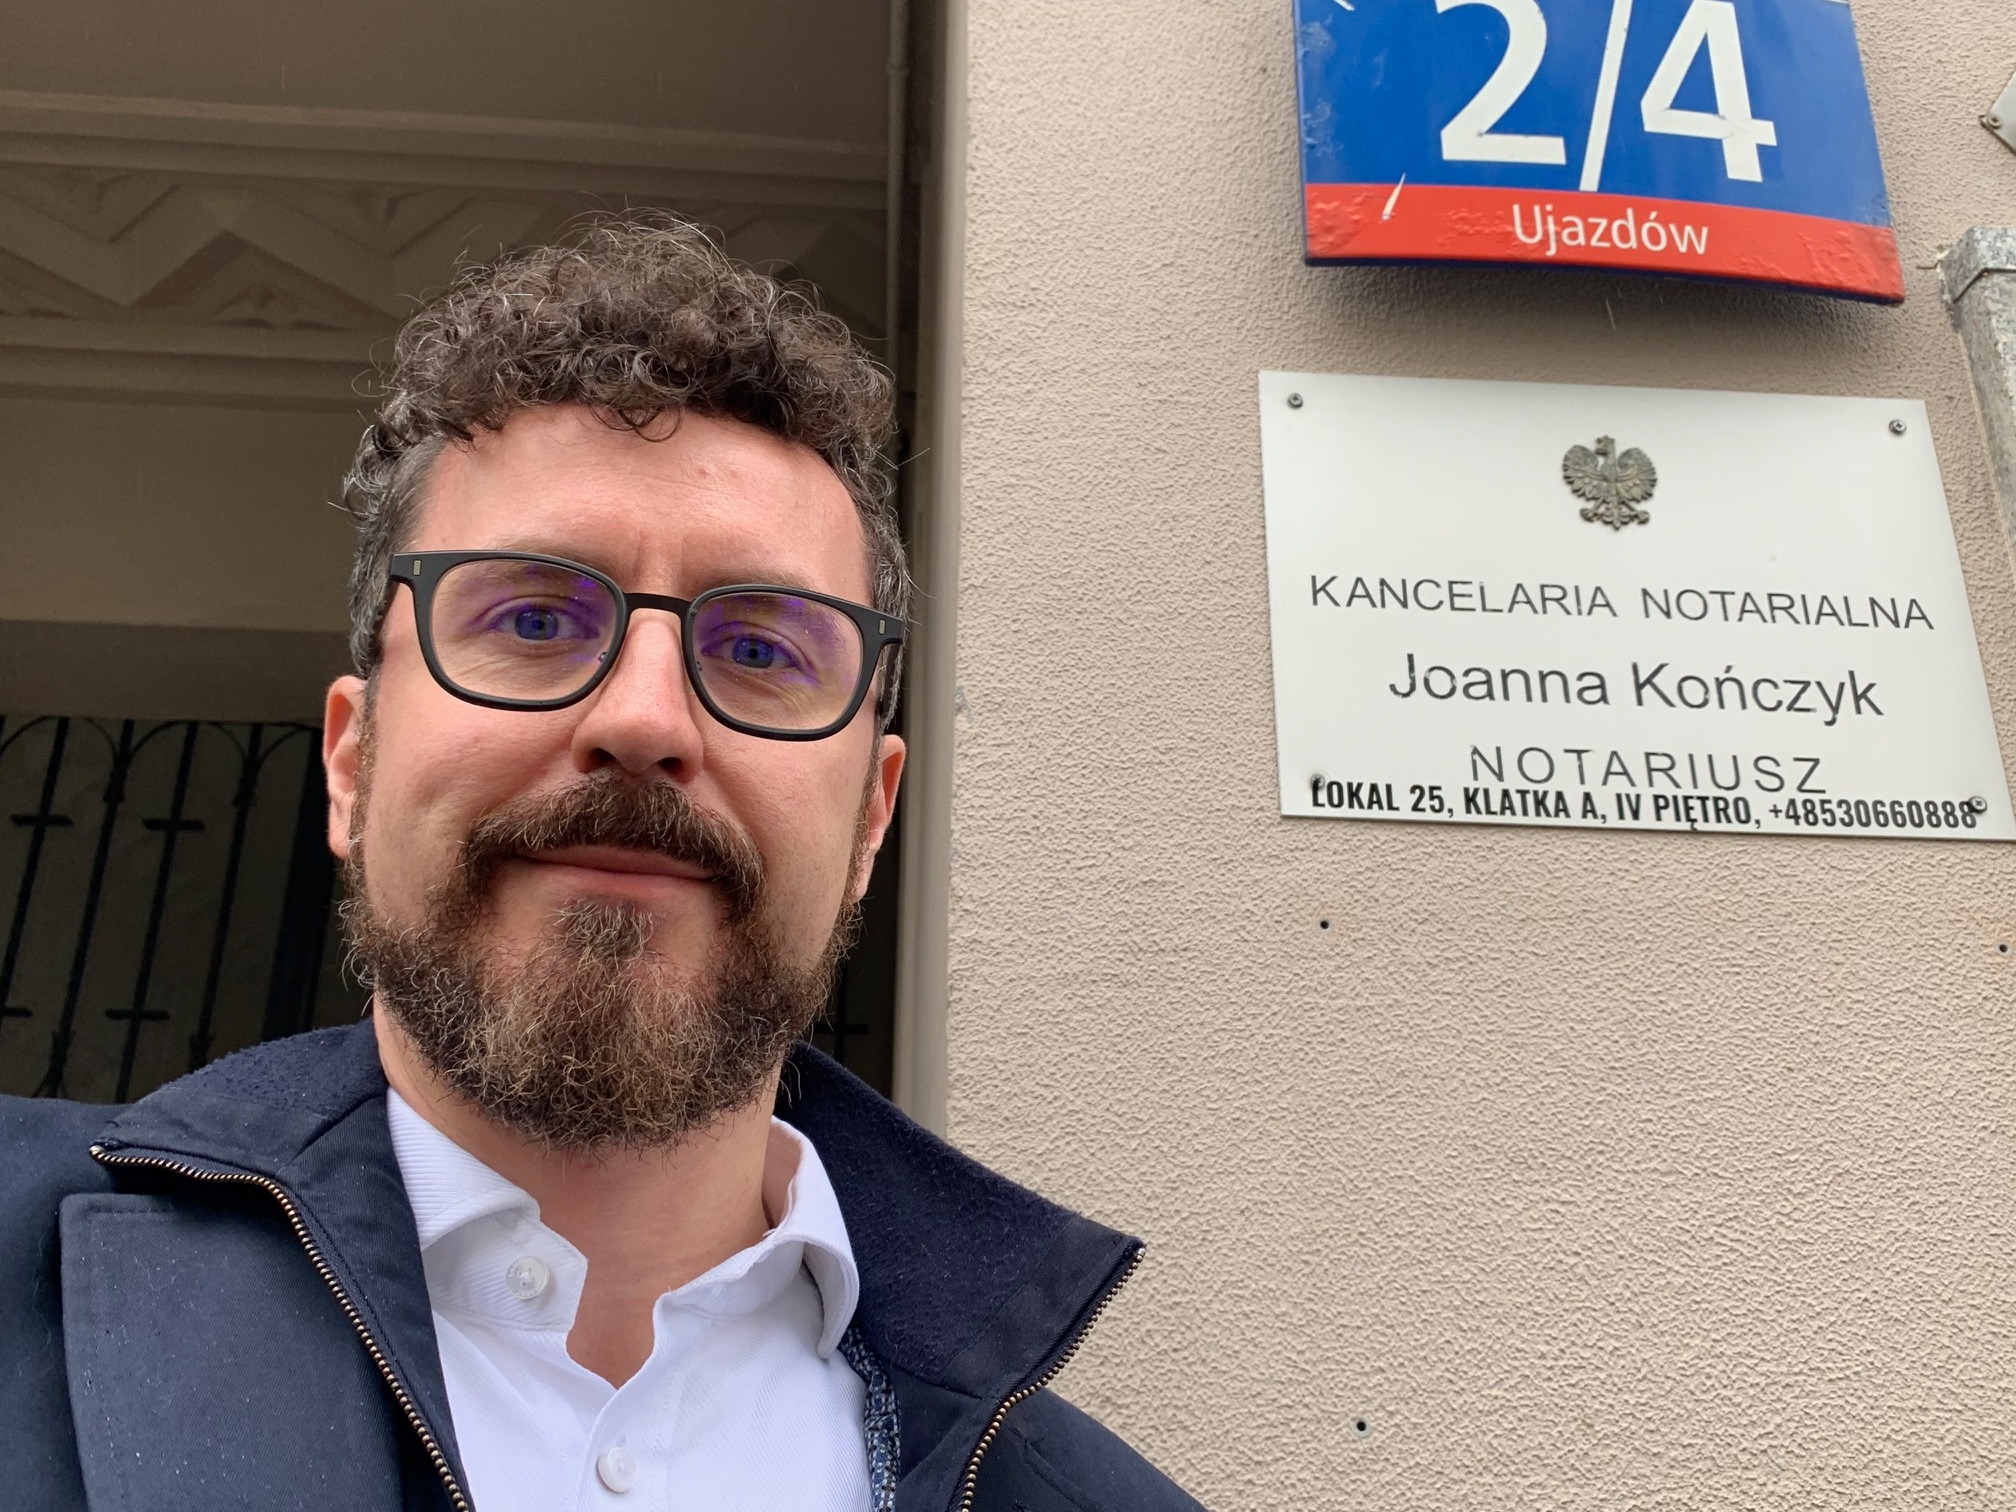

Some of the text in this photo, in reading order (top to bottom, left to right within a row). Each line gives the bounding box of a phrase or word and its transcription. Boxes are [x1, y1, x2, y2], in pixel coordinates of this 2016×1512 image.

[1435, 0, 1778, 193] 2/4
[1511, 203, 1709, 256] Ujazdów
[1310, 574, 1936, 631] KANCELARIA NOTARIALNA
[1388, 652, 1885, 728] Joanna Kończyk
[1469, 745, 1828, 795] NOTARIUSZ
[1311, 777, 1978, 832] LOKAL 25, KLATKA A, IV PIĘTRO, +48530660888
